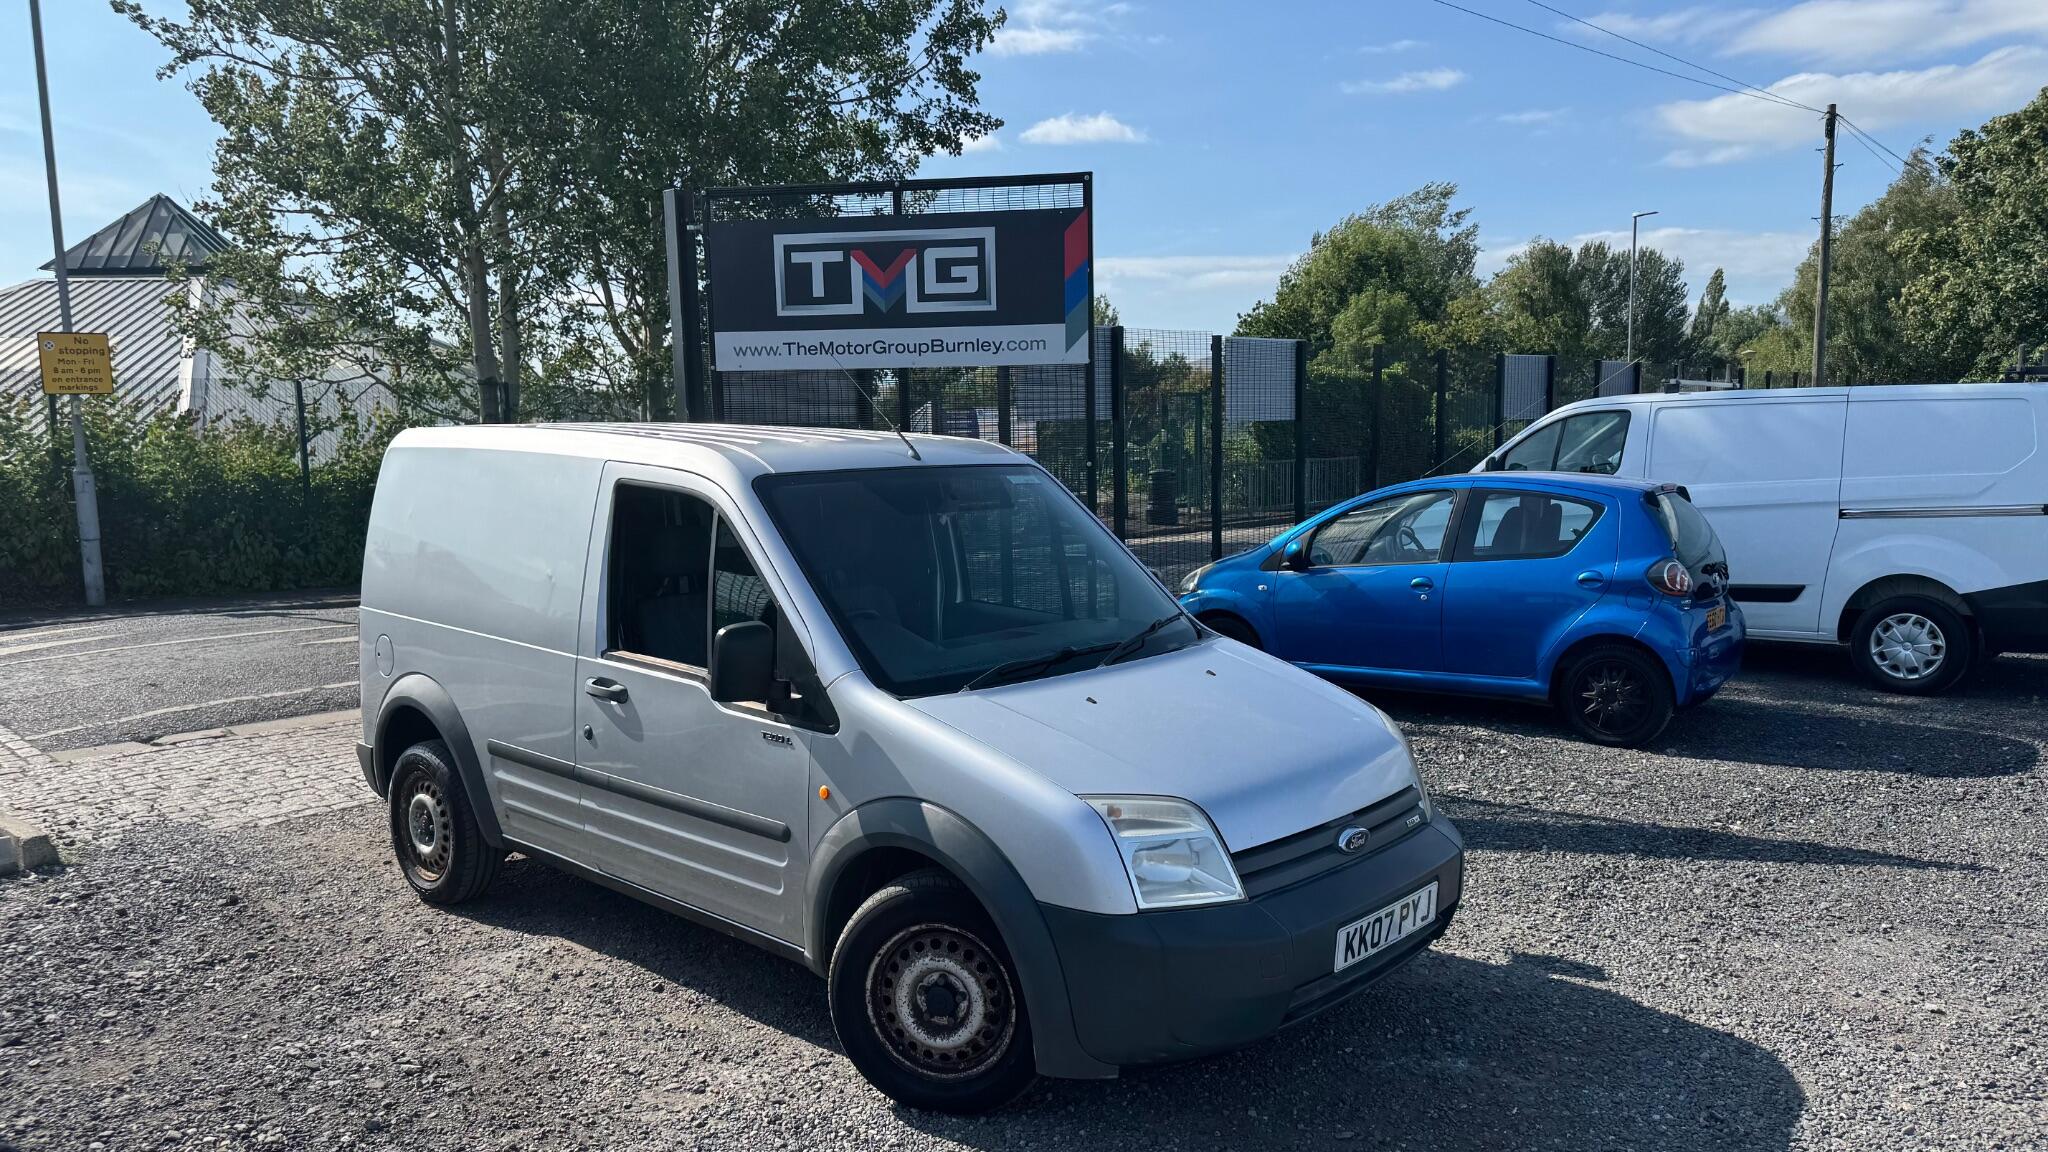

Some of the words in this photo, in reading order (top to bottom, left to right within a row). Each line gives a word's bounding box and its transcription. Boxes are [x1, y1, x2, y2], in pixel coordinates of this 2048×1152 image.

[790, 246, 979, 314] TMG
[74, 336, 89, 345] No
[59, 347, 105, 356] stopping
[733, 336, 1047, 358] www.TheMotorGroupBurnley.com
[57, 358, 77, 366] Mon
[83, 358, 95, 366] Fri
[80, 366, 86, 374] 6
[88, 367, 101, 375] pm
[1350, 833, 1366, 849] Ford
[1343, 909, 1395, 964] KK07
[1399, 889, 1433, 935] PYJ
